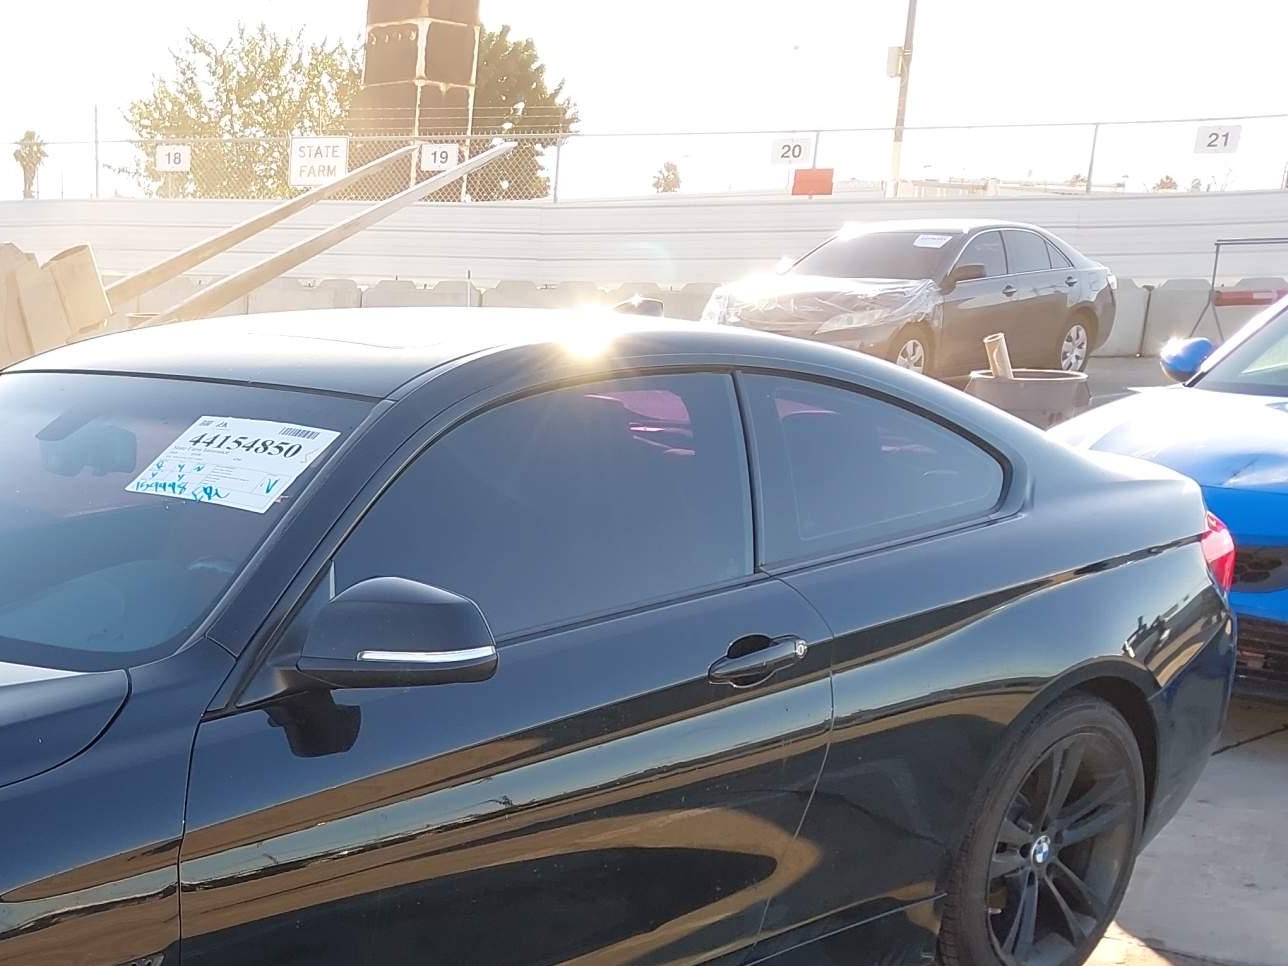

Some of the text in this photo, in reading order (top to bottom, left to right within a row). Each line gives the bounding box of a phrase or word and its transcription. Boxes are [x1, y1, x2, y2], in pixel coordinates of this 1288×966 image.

[1206, 132, 1230, 148] 21
[164, 151, 182, 166] 18
[297, 144, 341, 159] STATE
[430, 150, 449, 164] 19
[780, 144, 802, 159] 20
[298, 164, 338, 178] FARM
[188, 432, 303, 459] 44154850
